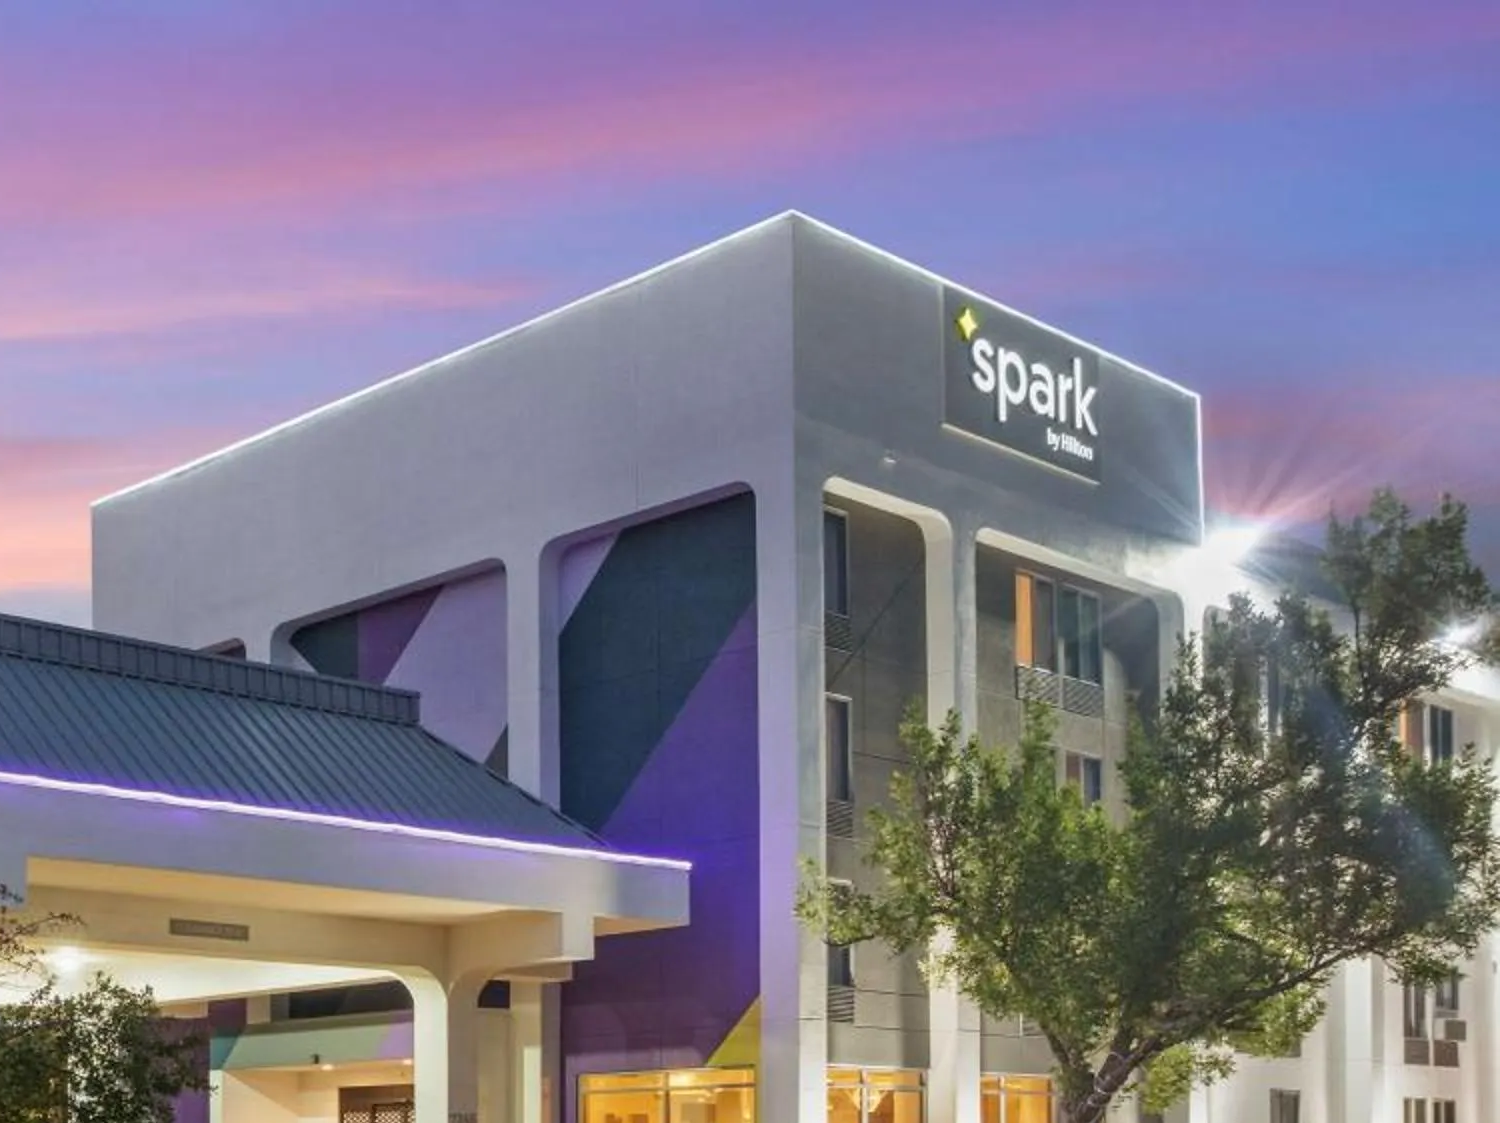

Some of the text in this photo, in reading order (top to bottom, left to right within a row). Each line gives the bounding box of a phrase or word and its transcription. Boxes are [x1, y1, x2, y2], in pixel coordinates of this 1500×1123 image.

[972, 338, 1098, 436] spark
[1047, 427, 1093, 461] by Hilton
